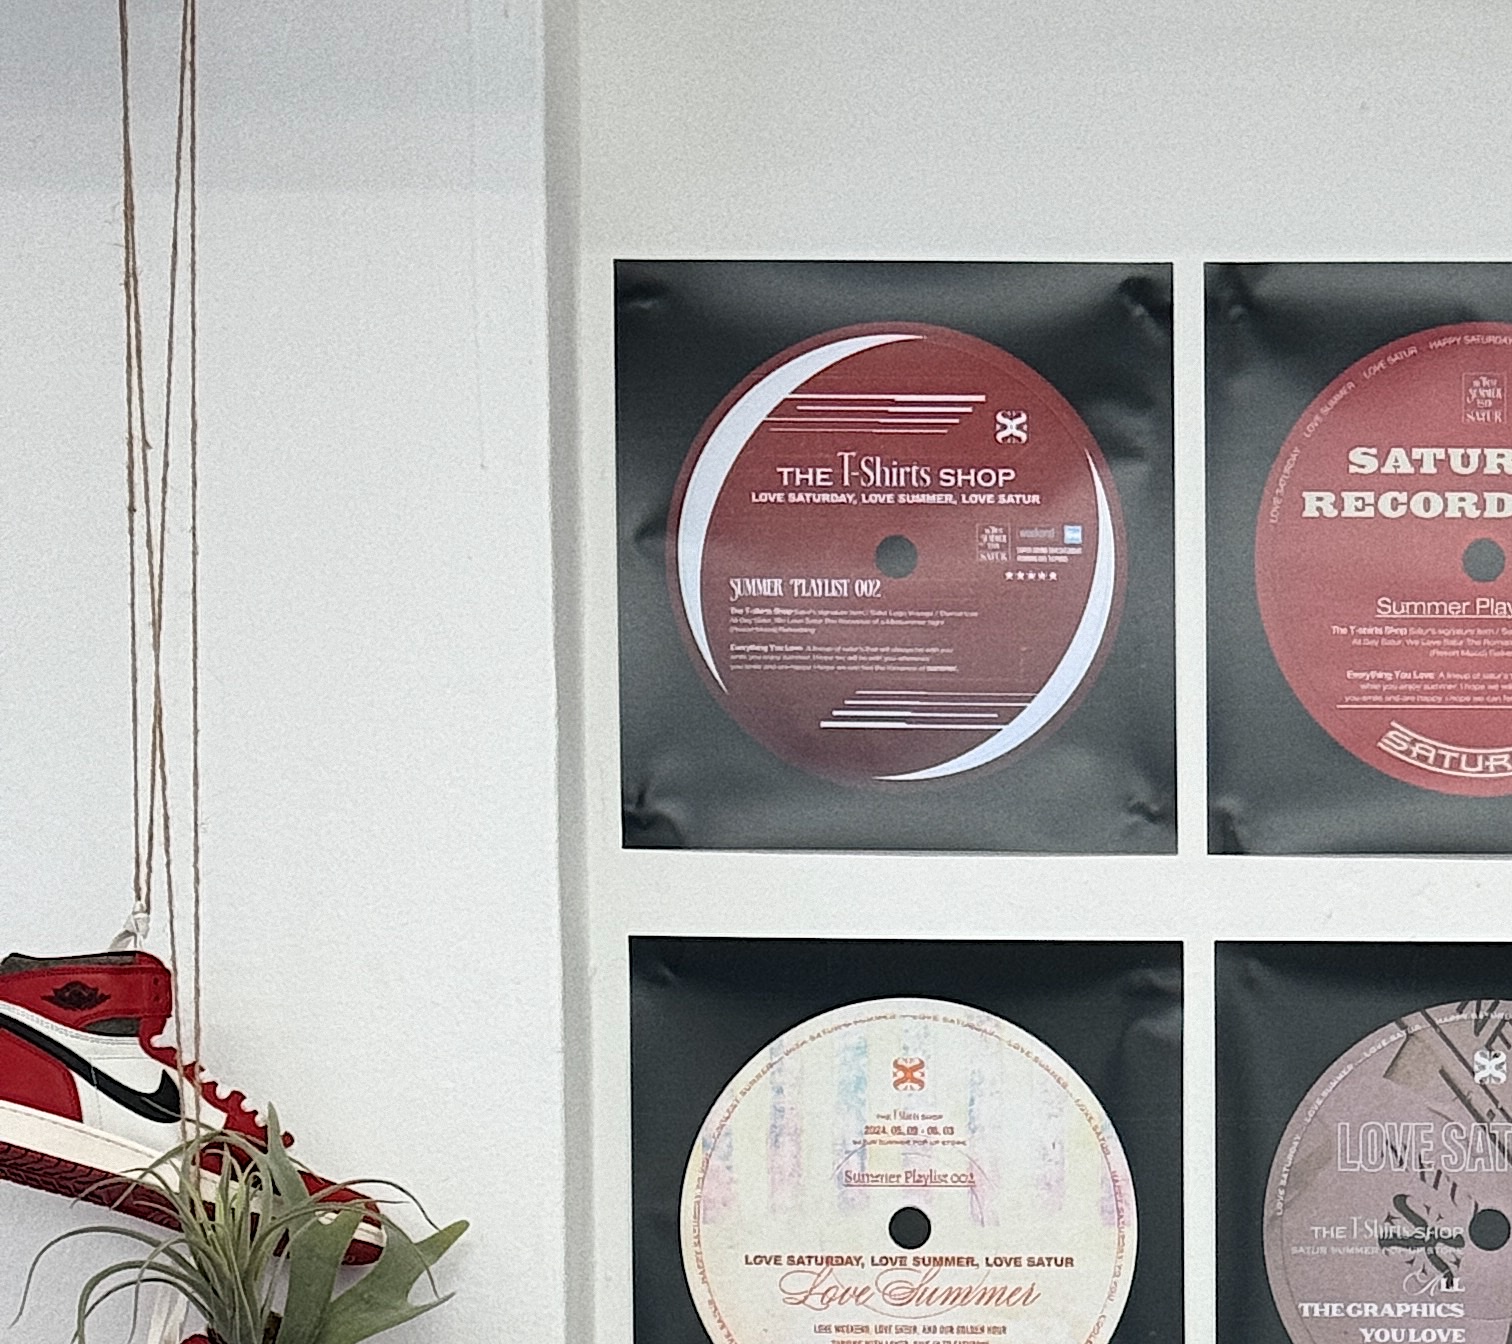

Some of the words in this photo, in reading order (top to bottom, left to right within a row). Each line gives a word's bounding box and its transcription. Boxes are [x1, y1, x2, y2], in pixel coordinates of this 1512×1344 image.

[776, 467, 833, 488] THE
[836, 451, 931, 488] T-Shirts
[938, 468, 1017, 488] SHOP
[751, 492, 785, 504] LOVE
[787, 492, 858, 506] SATURDAY,
[861, 492, 895, 504] LOVE
[898, 493, 957, 506] SUMMER,
[961, 493, 994, 505] LOVE
[997, 493, 1041, 505] SATUR
[729, 577, 785, 601] SUMMER
[854, 578, 883, 598] 002
[1376, 596, 1470, 616] Summer
[1336, 1121, 1434, 1173] LOVE
[1310, 1226, 1348, 1239] THE
[1413, 1226, 1465, 1239] SHOP
[744, 1254, 783, 1267] LOVE
[786, 1254, 866, 1270] SATURDAY,
[870, 1254, 908, 1267] LOVE
[984, 1255, 1023, 1268] LOVE
[1025, 1256, 1075, 1268] SATUR
[778, 1266, 875, 1311] Love
[874, 1262, 1041, 1309] Summer
[1298, 1302, 1346, 1318] THE
[1346, 1302, 1465, 1318] GRAPHICS
[1358, 1327, 1407, 1343] YOU
[1407, 1328, 1466, 1343] LOVE
